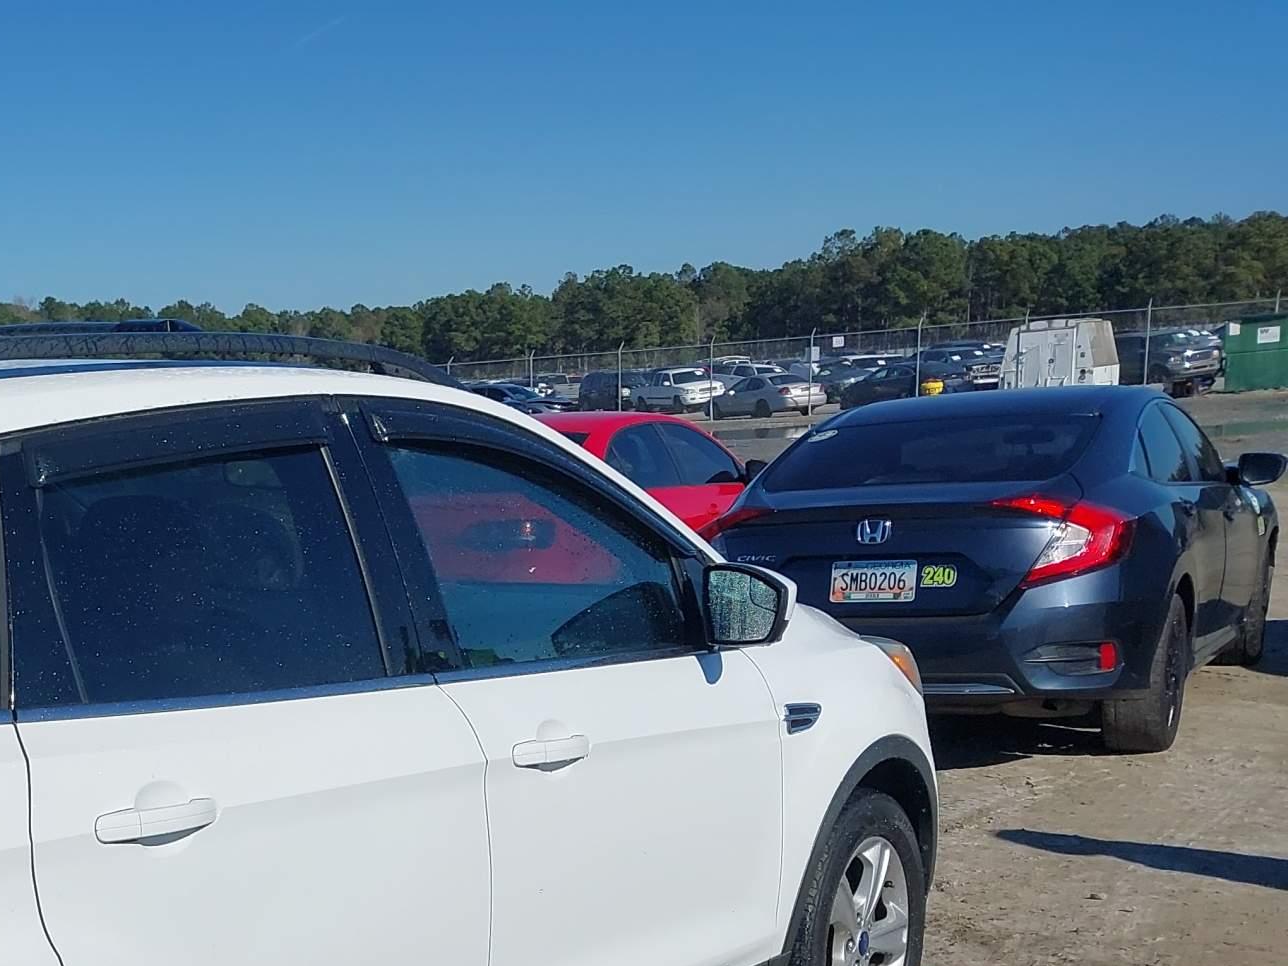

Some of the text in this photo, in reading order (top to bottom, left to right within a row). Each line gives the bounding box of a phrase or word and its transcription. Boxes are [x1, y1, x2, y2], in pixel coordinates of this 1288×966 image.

[737, 554, 777, 562] CIVIC
[840, 571, 906, 592] SMB0206
[922, 566, 955, 587] 240
